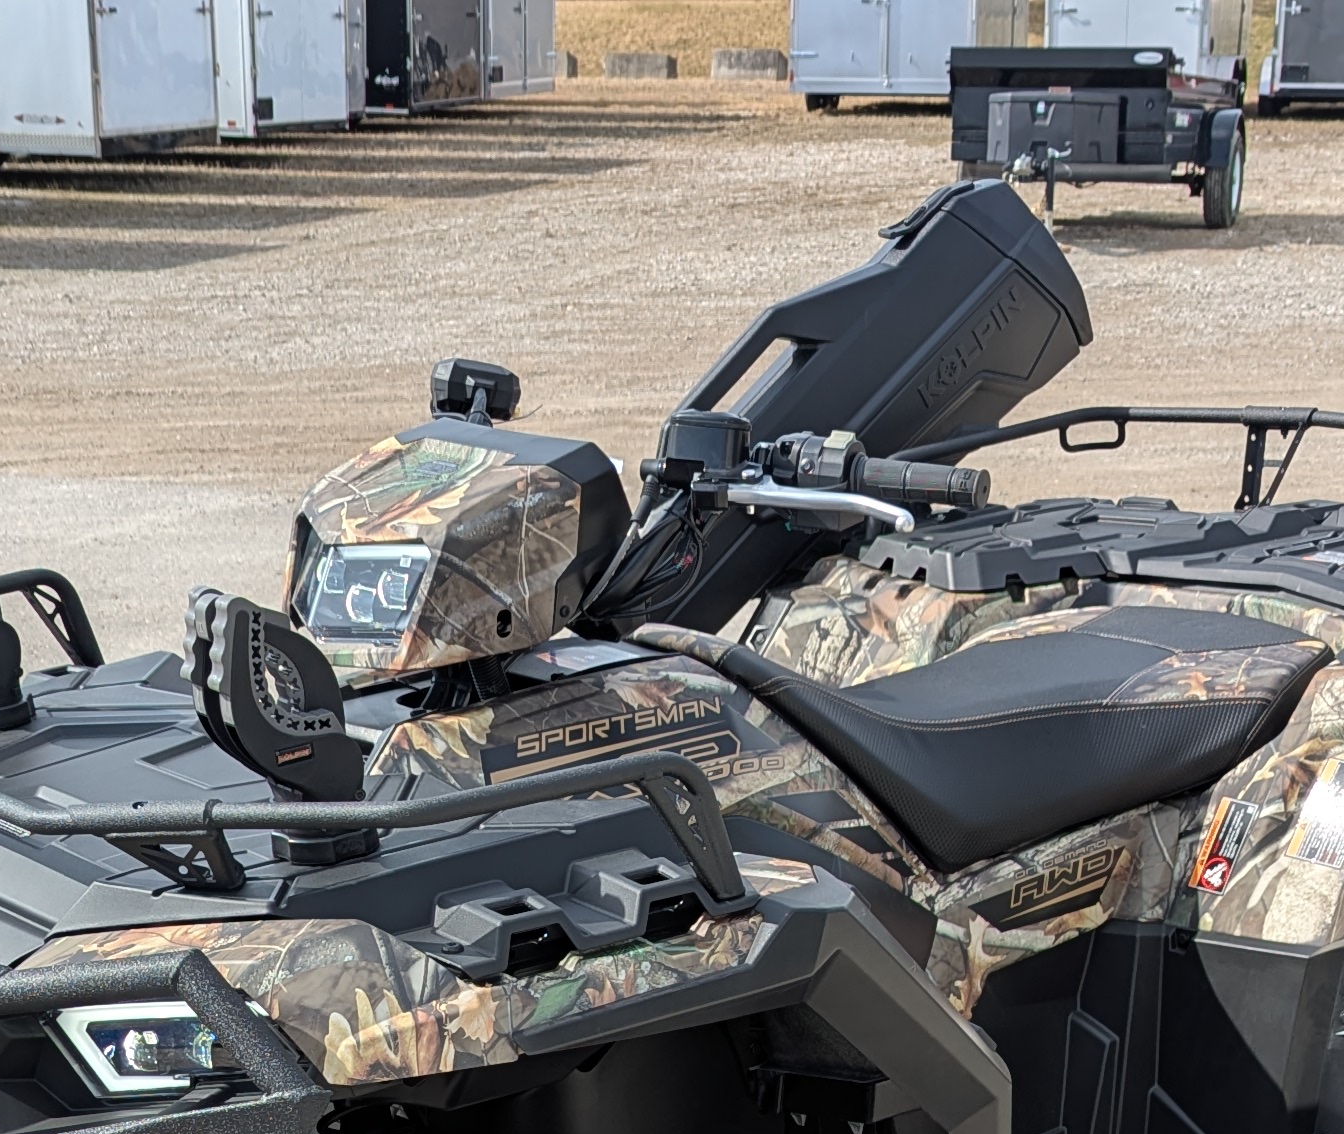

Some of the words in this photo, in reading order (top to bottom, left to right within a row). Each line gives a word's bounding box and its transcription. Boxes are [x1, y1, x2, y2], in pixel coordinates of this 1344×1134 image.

[917, 286, 1025, 408] KOLPIN
[516, 697, 722, 758] SPORTSMAN
[1010, 848, 1115, 908] AWD
